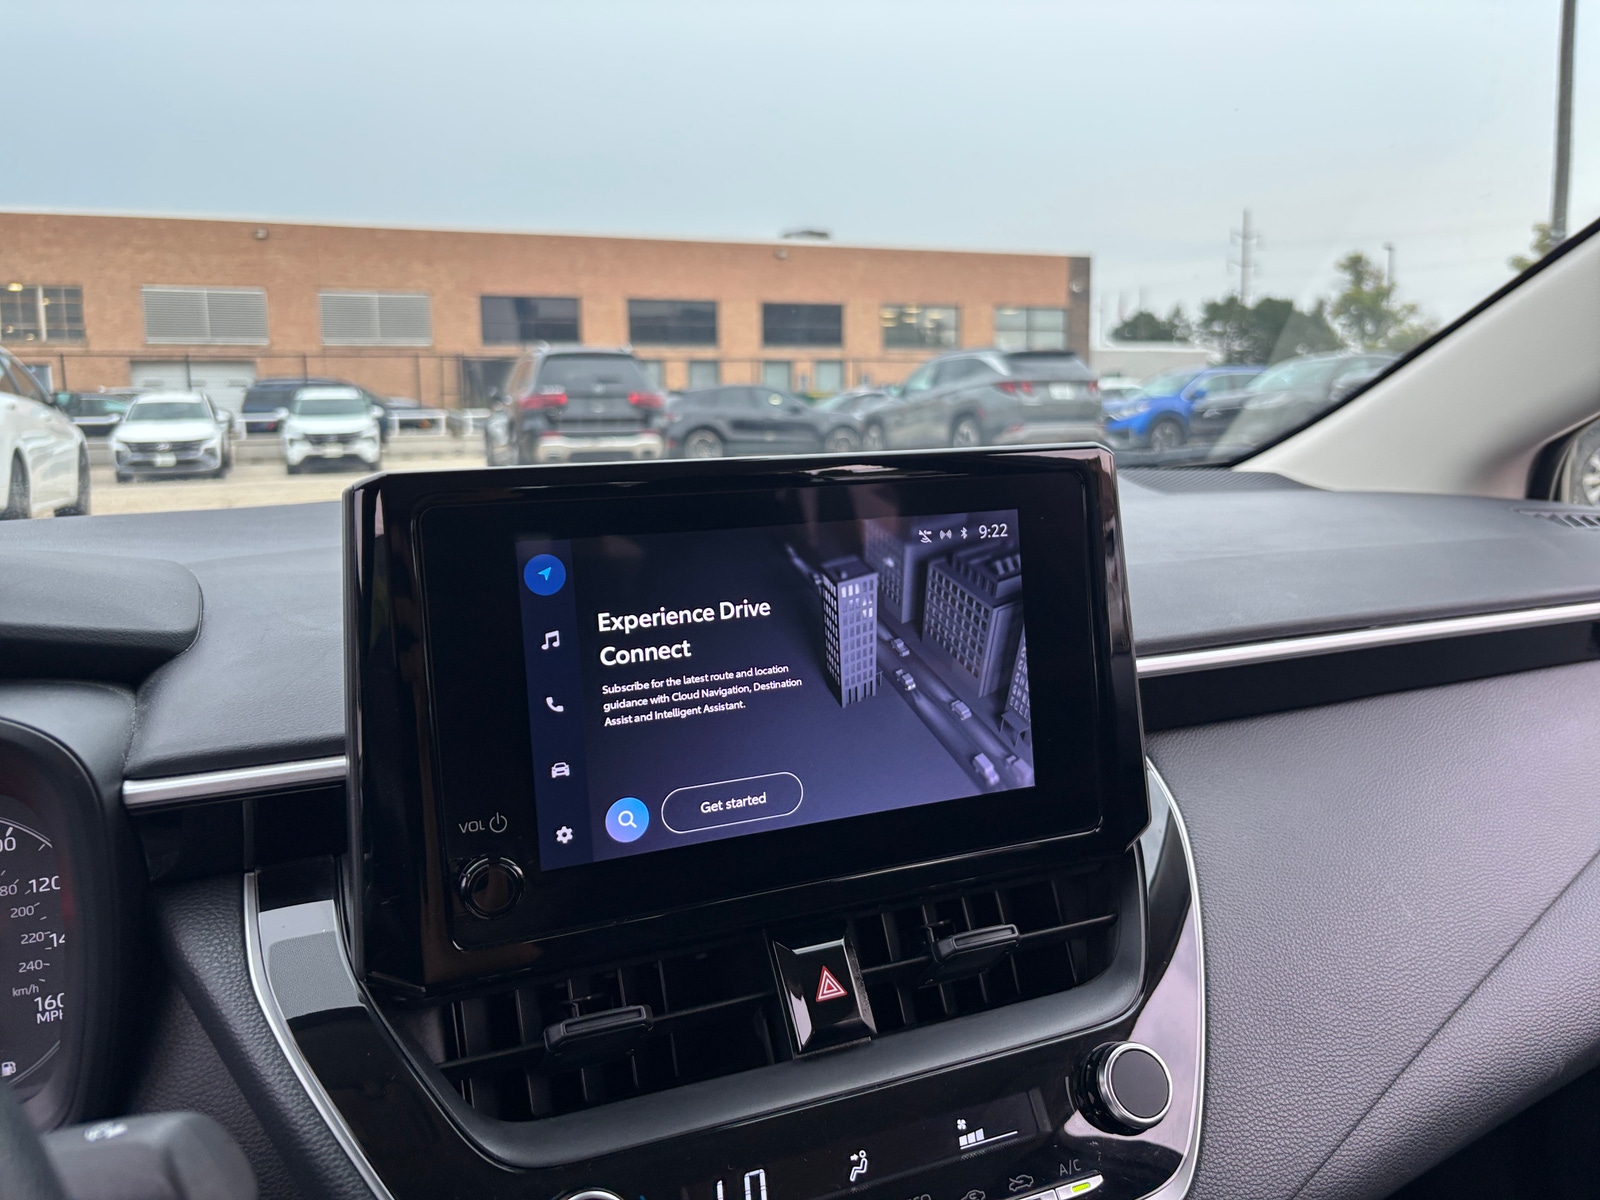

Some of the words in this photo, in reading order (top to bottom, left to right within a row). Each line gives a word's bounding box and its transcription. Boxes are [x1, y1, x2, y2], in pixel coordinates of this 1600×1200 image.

[979, 523, 1008, 539] 9:22
[597, 606, 715, 634] Experience
[719, 598, 771, 620] Drive
[600, 639, 692, 666] Connect
[602, 681, 650, 695] Subscribe
[651, 679, 665, 689] for
[666, 677, 681, 687] the
[683, 673, 709, 685] latest
[710, 671, 734, 682] route
[735, 667, 753, 678] and
[754, 665, 789, 676] location
[603, 699, 648, 713] guidance
[650, 694, 670, 705] with
[672, 689, 700, 702] Cloud
[701, 685, 752, 698] Navigation,
[753, 678, 802, 691] Destination
[604, 715, 633, 727] Assist
[634, 711, 653, 723] and
[654, 706, 702, 719] Intelligent
[703, 700, 746, 713] Assistant.
[700, 800, 724, 813] Get
[725, 791, 767, 809] started
[458, 820, 486, 834] VOL
[10, 905, 35, 918] 200
[20, 931, 44, 944] 220
[18, 959, 43, 973] 240
[12, 984, 39, 997] km/h
[1060, 1159, 1081, 1176] A/C
